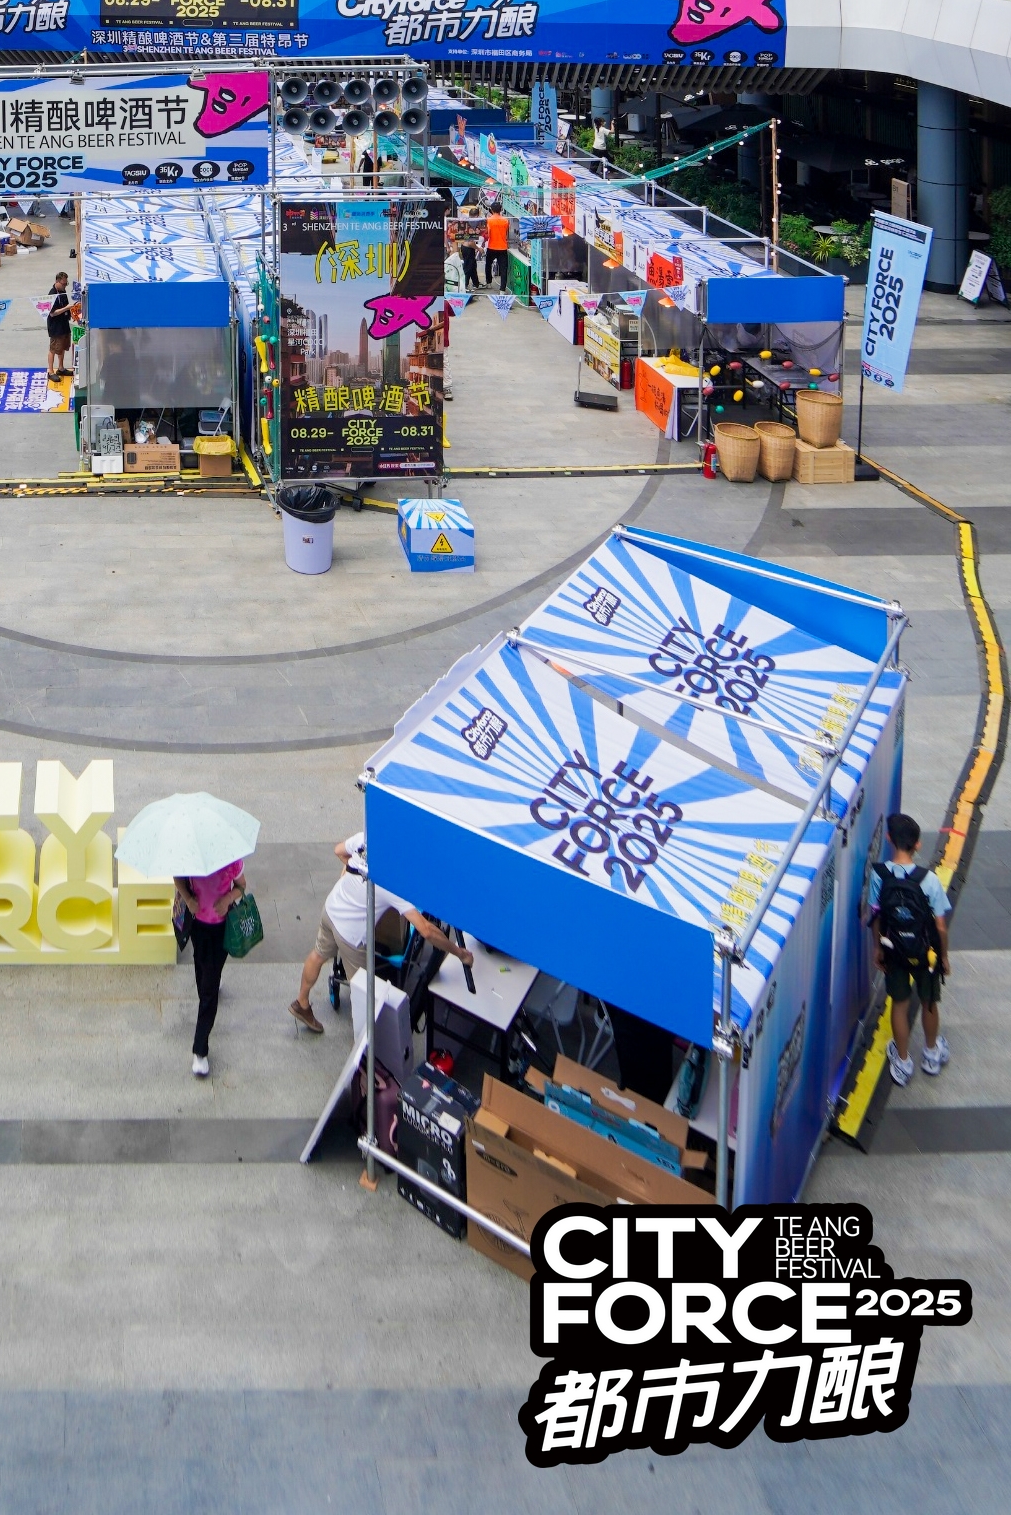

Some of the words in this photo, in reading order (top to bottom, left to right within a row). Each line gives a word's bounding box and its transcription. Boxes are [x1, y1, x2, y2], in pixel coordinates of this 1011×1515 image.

[176, 5, 220, 18] 2025
[385, 4, 537, 45] 都市力酿
[91, 30, 309, 49] 深圳精酿啤酒节&第三届特昂节
[137, 46, 182, 54] SHENZHEN
[215, 47, 237, 55] BEER
[238, 47, 277, 56] FESTIVAL
[14, 135, 35, 149] TE
[39, 134, 74, 149] ANG
[78, 133, 115, 148] BEER
[118, 131, 186, 147] FESTIVAL
[15, 155, 84, 171] FORCE
[159, 166, 178, 177] 36Kr
[302, 222, 349, 232] SHENZHEN
[350, 222, 360, 231] TE
[362, 222, 381, 231] ANG
[383, 222, 403, 231] BEER
[405, 221, 443, 231] FESTIVAL
[871, 247, 895, 311] FORCE
[879, 276, 904, 342] 2025
[865, 312, 881, 357] CITY
[293, 380, 431, 414] 精酿啤酒节
[291, 427, 334, 439] 08.29-
[341, 428, 384, 437] FORCE
[347, 419, 378, 429] CITY
[393, 425, 434, 437] -08.31
[346, 436, 379, 446] 2025
[649, 616, 706, 678] CITY
[672, 623, 749, 712] FORCE
[715, 648, 776, 716] 2025
[530, 749, 603, 831] CITY
[552, 760, 654, 878] FORCE
[603, 792, 684, 894] 2025
[402, 1102, 453, 1146] MICRO
